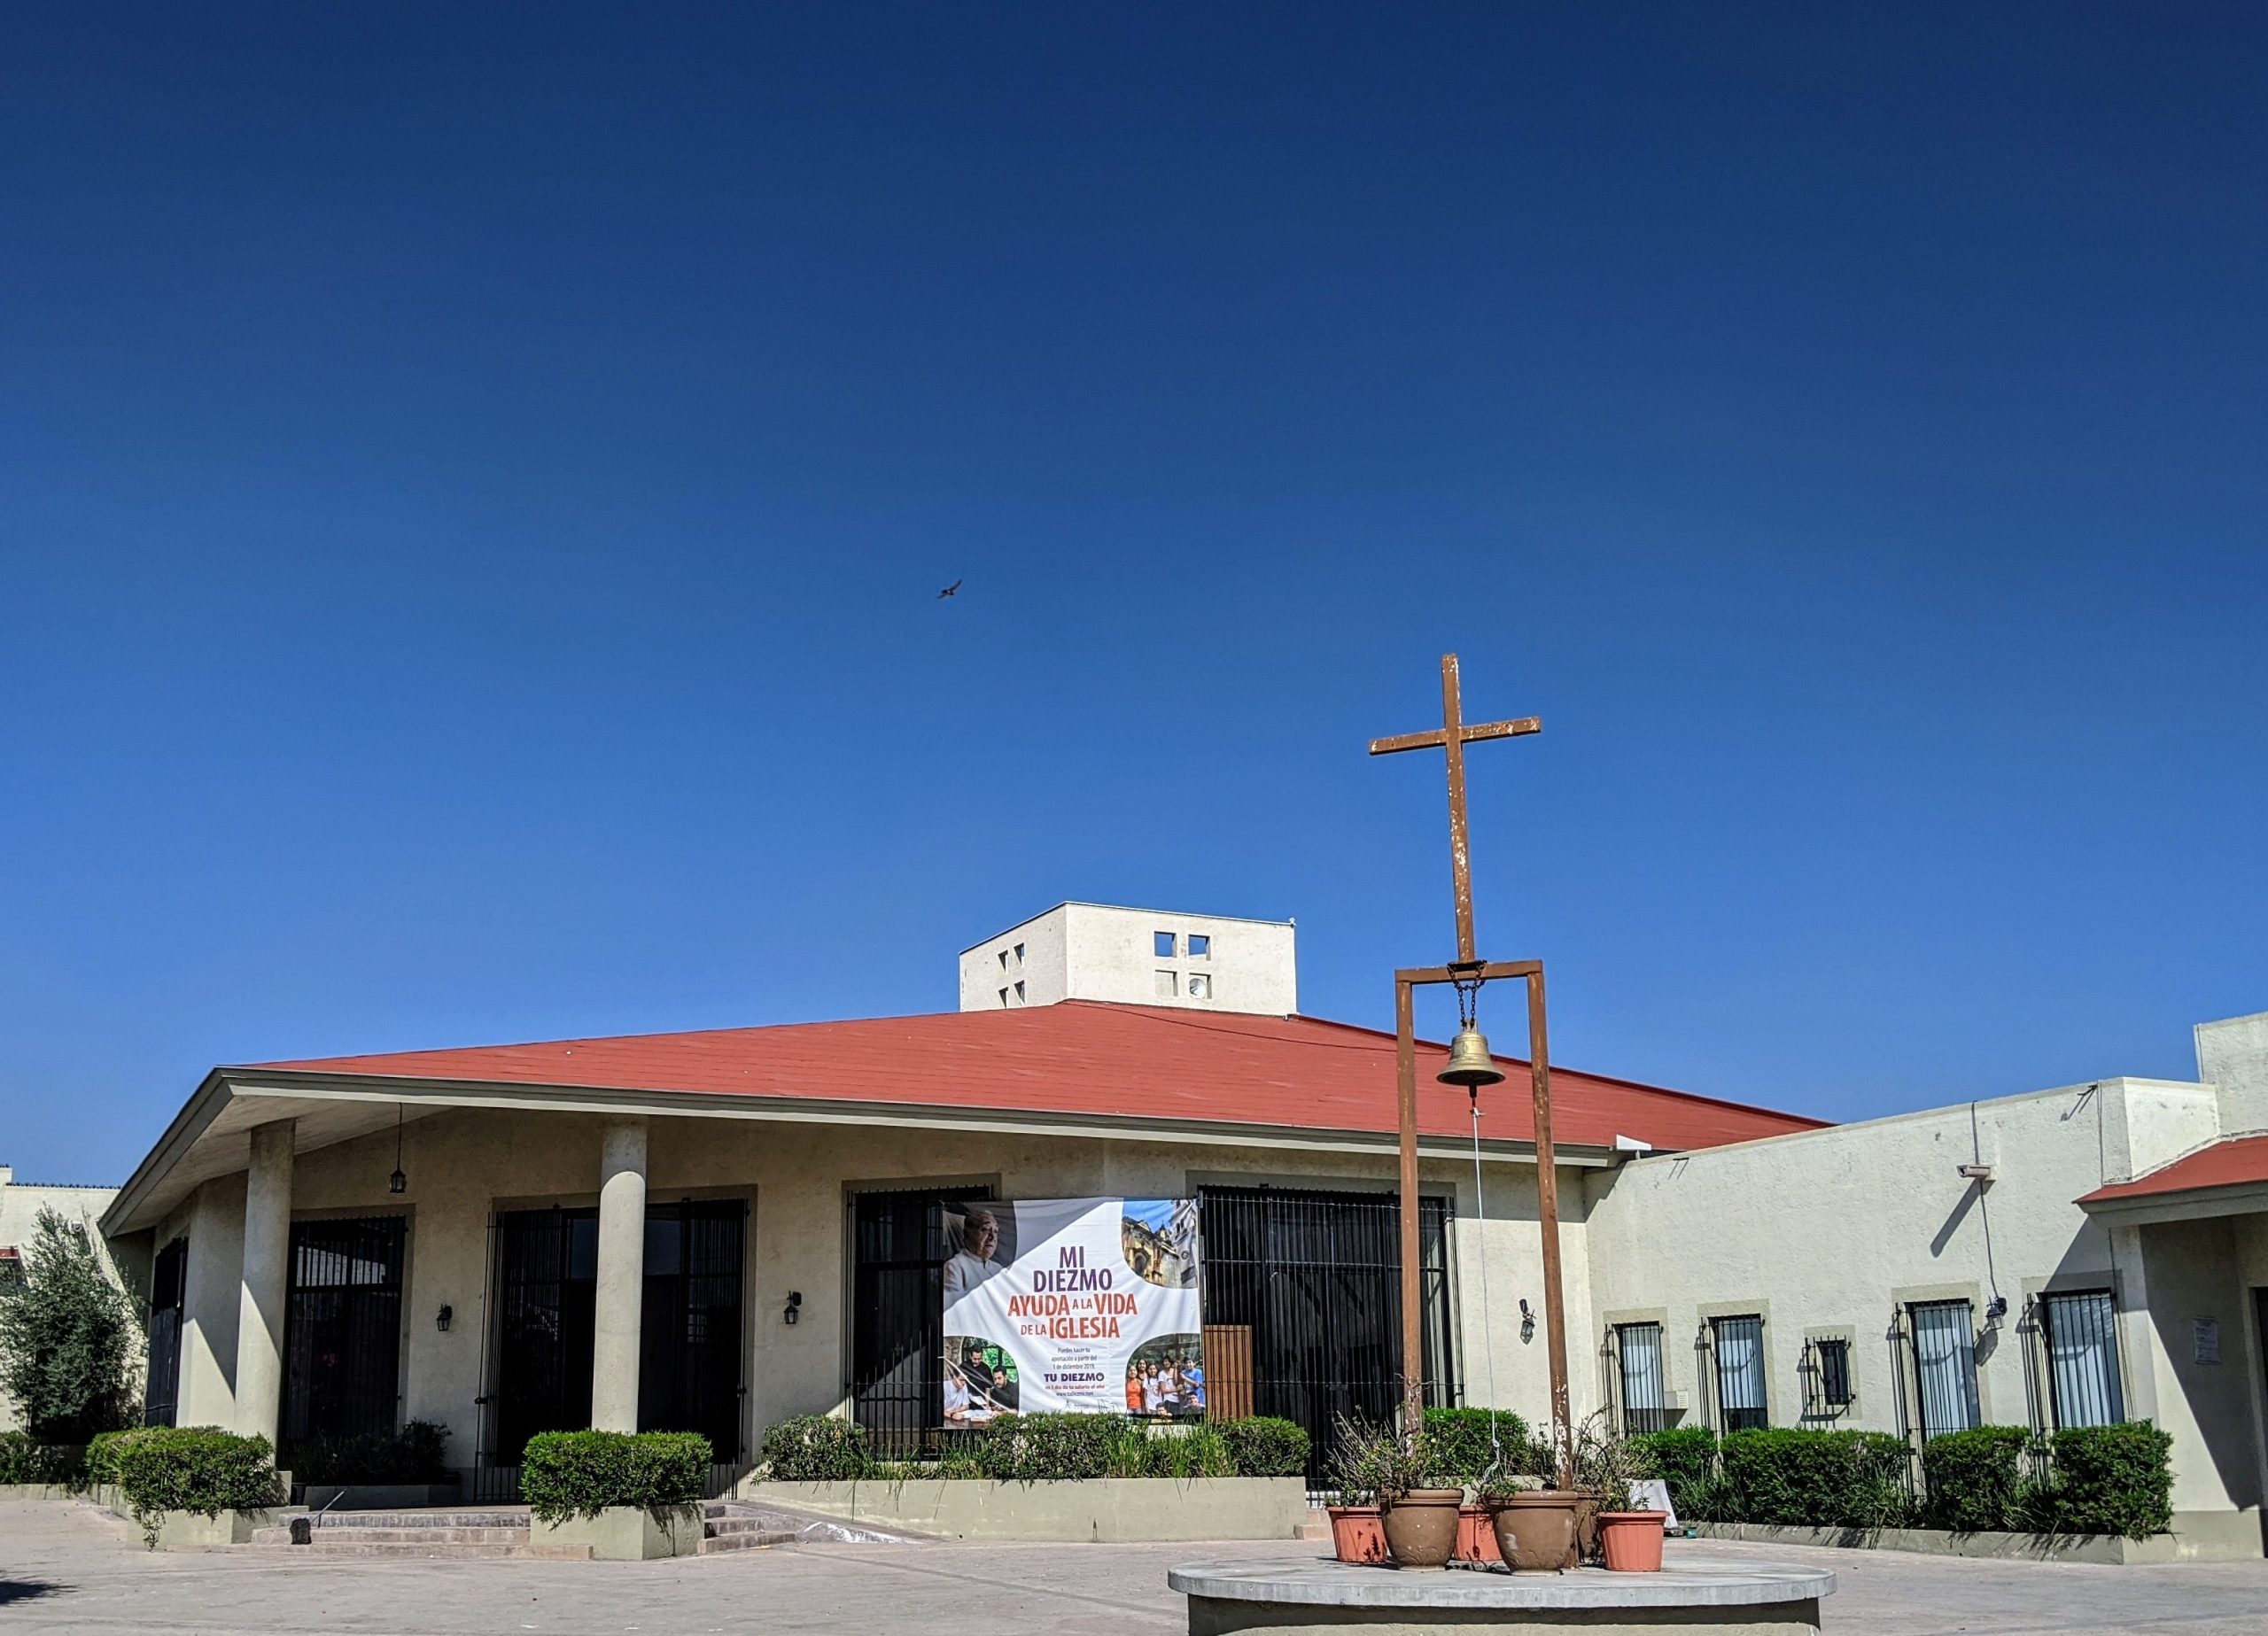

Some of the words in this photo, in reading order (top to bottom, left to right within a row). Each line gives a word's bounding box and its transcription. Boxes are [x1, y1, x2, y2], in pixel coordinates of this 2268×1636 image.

[1060, 1246, 1084, 1268] MI
[1033, 1268, 1113, 1292] DIEZMO
[1007, 1294, 1070, 1316] AYUDA
[1072, 1299, 1079, 1310] A
[1081, 1299, 1093, 1309] LA
[1094, 1293, 1138, 1315] VIDA
[1021, 1324, 1033, 1335] DE
[1035, 1324, 1046, 1335] LA
[1049, 1317, 1120, 1339] IGLESIA
[1044, 1374, 1057, 1383] TU
[1061, 1372, 1105, 1382] DIEZMO
